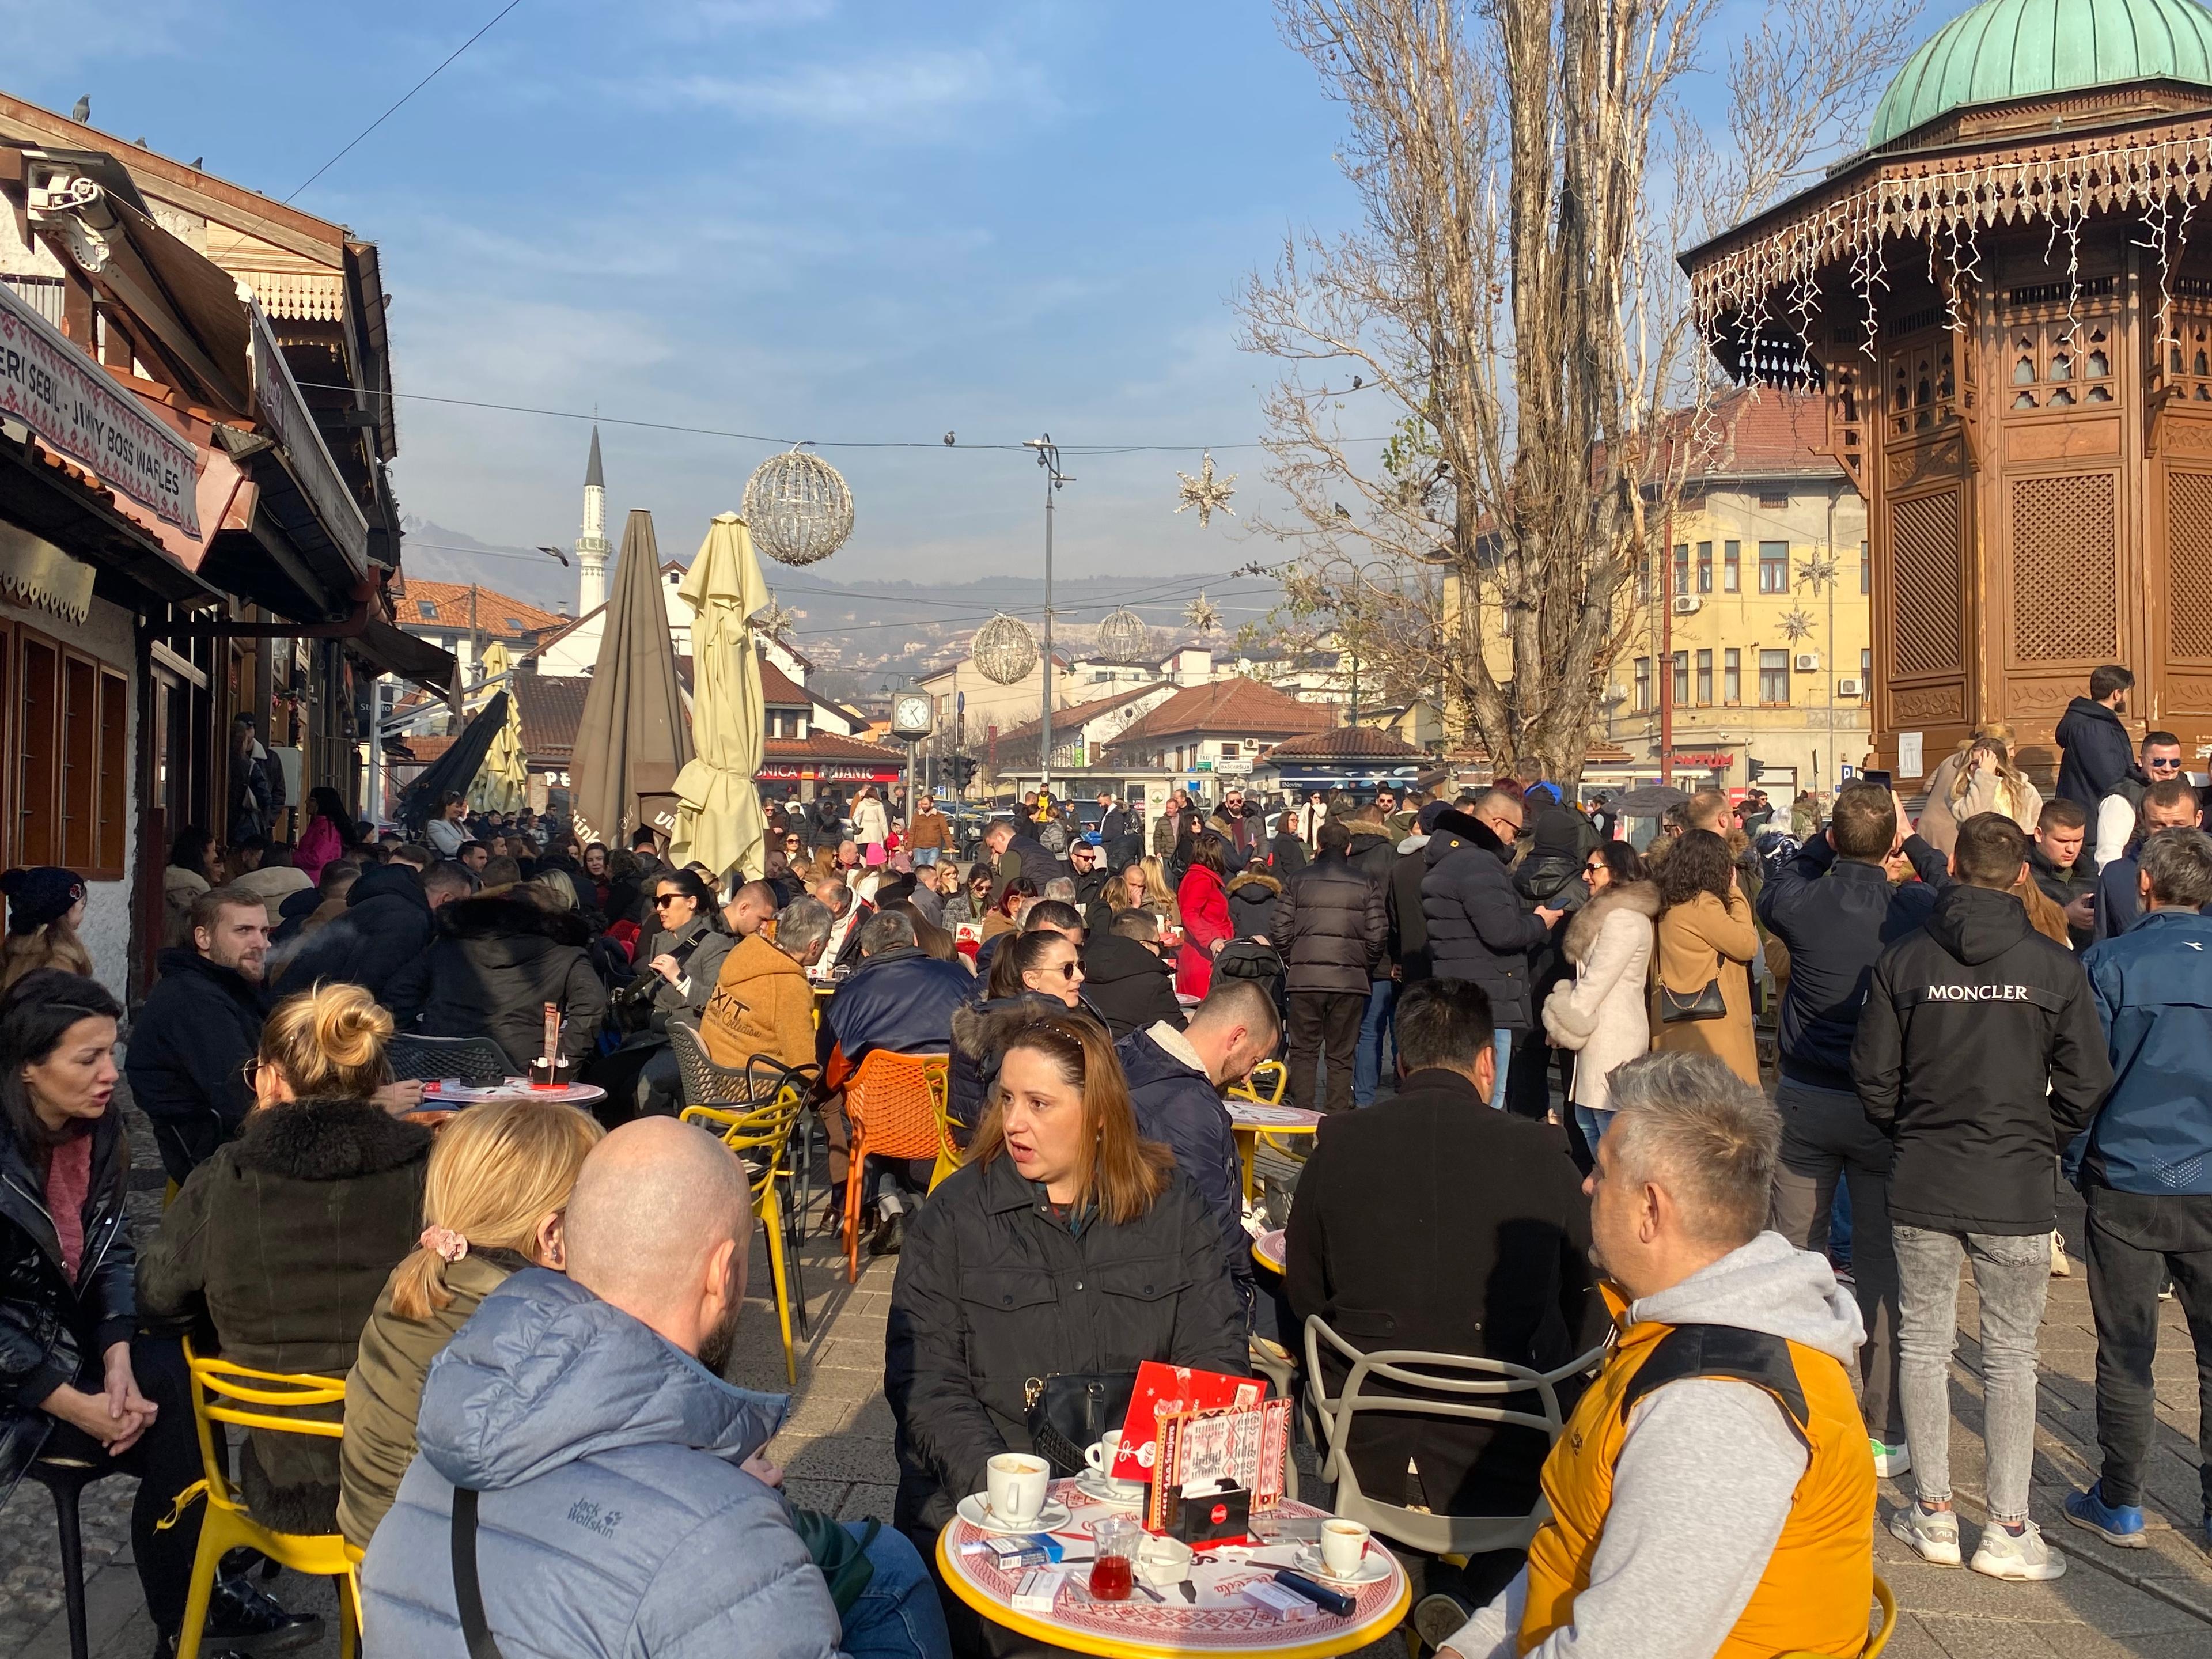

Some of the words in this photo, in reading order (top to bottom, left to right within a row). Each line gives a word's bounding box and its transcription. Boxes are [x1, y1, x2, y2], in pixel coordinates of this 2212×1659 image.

[29, 363, 60, 414] SEBIL
[108, 427, 134, 467] BOSS
[137, 447, 179, 496] WAFLES
[1927, 985, 2029, 1001] MONCLER
[1165, 1425, 1175, 1464] Sarajevo
[567, 1507, 613, 1539] Wolfskin
[574, 1497, 602, 1517] Jack
